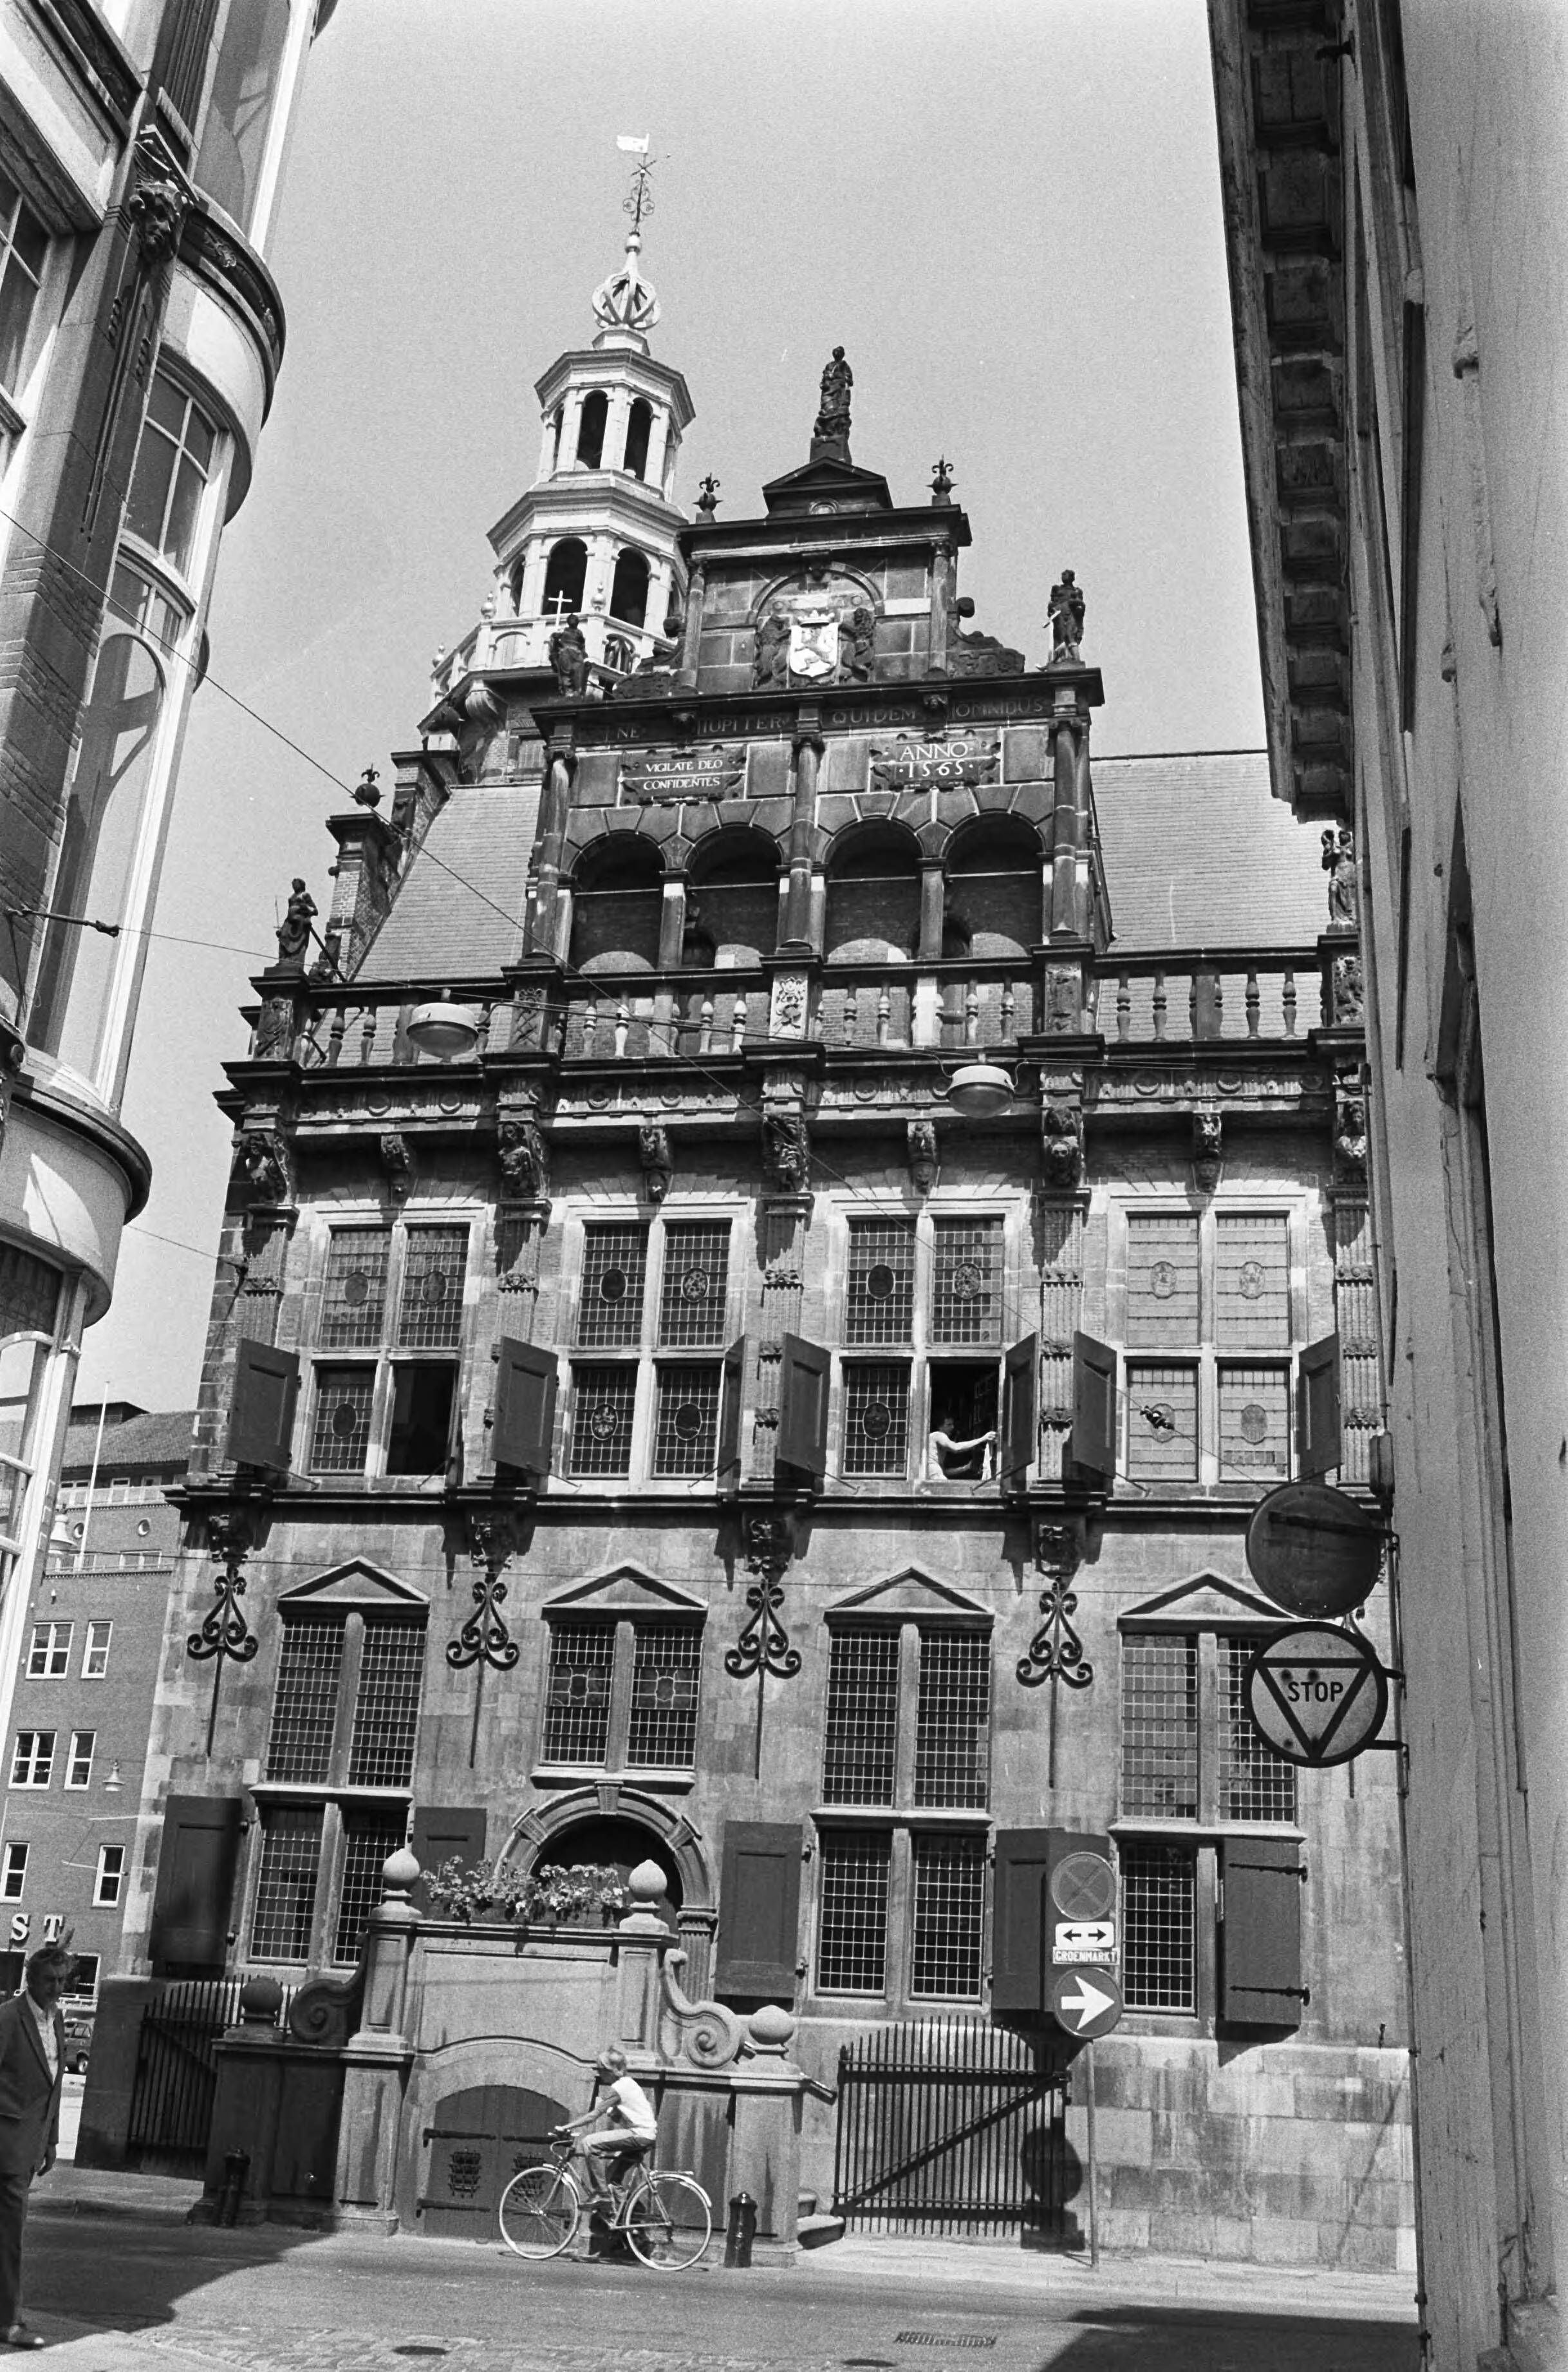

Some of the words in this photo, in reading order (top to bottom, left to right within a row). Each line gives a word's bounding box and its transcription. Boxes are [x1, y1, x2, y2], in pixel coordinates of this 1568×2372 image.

[832, 708, 917, 724] QUIDEM
[645, 760, 694, 773] VIGILATE
[698, 758, 723, 770] DEO
[643, 777, 721, 791] CONFIDENTES
[1287, 1680, 1344, 1702] STOP
[1054, 1950, 1116, 1963] GROENMARKT
